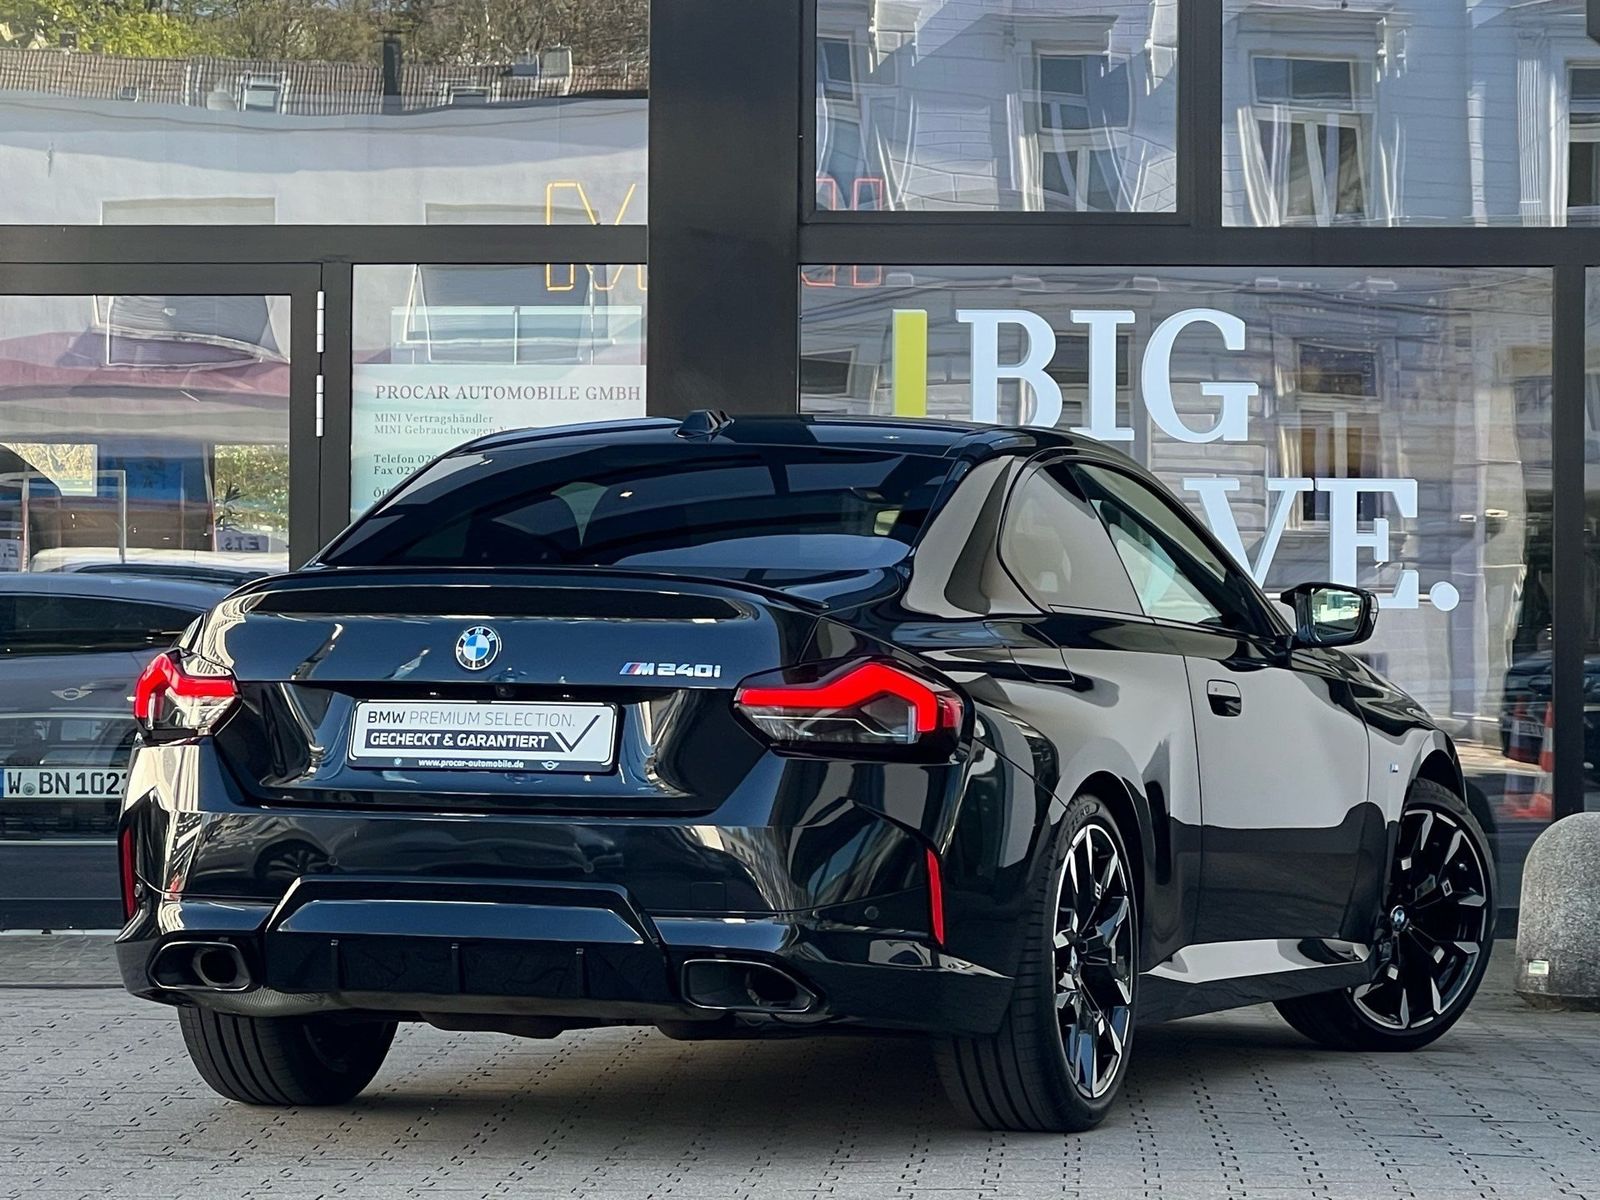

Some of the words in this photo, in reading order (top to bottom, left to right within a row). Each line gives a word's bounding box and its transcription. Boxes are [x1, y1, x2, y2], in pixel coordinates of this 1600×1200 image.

[956, 308, 1258, 443] BIG
[375, 385, 450, 400] PROCAR
[456, 385, 580, 401] AUTOMOBILE
[585, 386, 640, 401] GMBH
[374, 413, 401, 423] MINI
[405, 412, 494, 425] Vertragshändler
[374, 424, 401, 434] MINI
[374, 454, 414, 463] Telefon
[374, 466, 393, 475] Fax
[367, 710, 406, 724] BMW
[409, 710, 480, 725] PREMIUM
[485, 711, 576, 727] SELECTION.
[370, 732, 441, 746] GECHECKT
[442, 733, 454, 746] &
[456, 733, 549, 748] GARANTIERT
[418, 759, 525, 769] www.procar-automobile.de
[7, 771, 22, 795] W
[39, 771, 70, 795] BN
